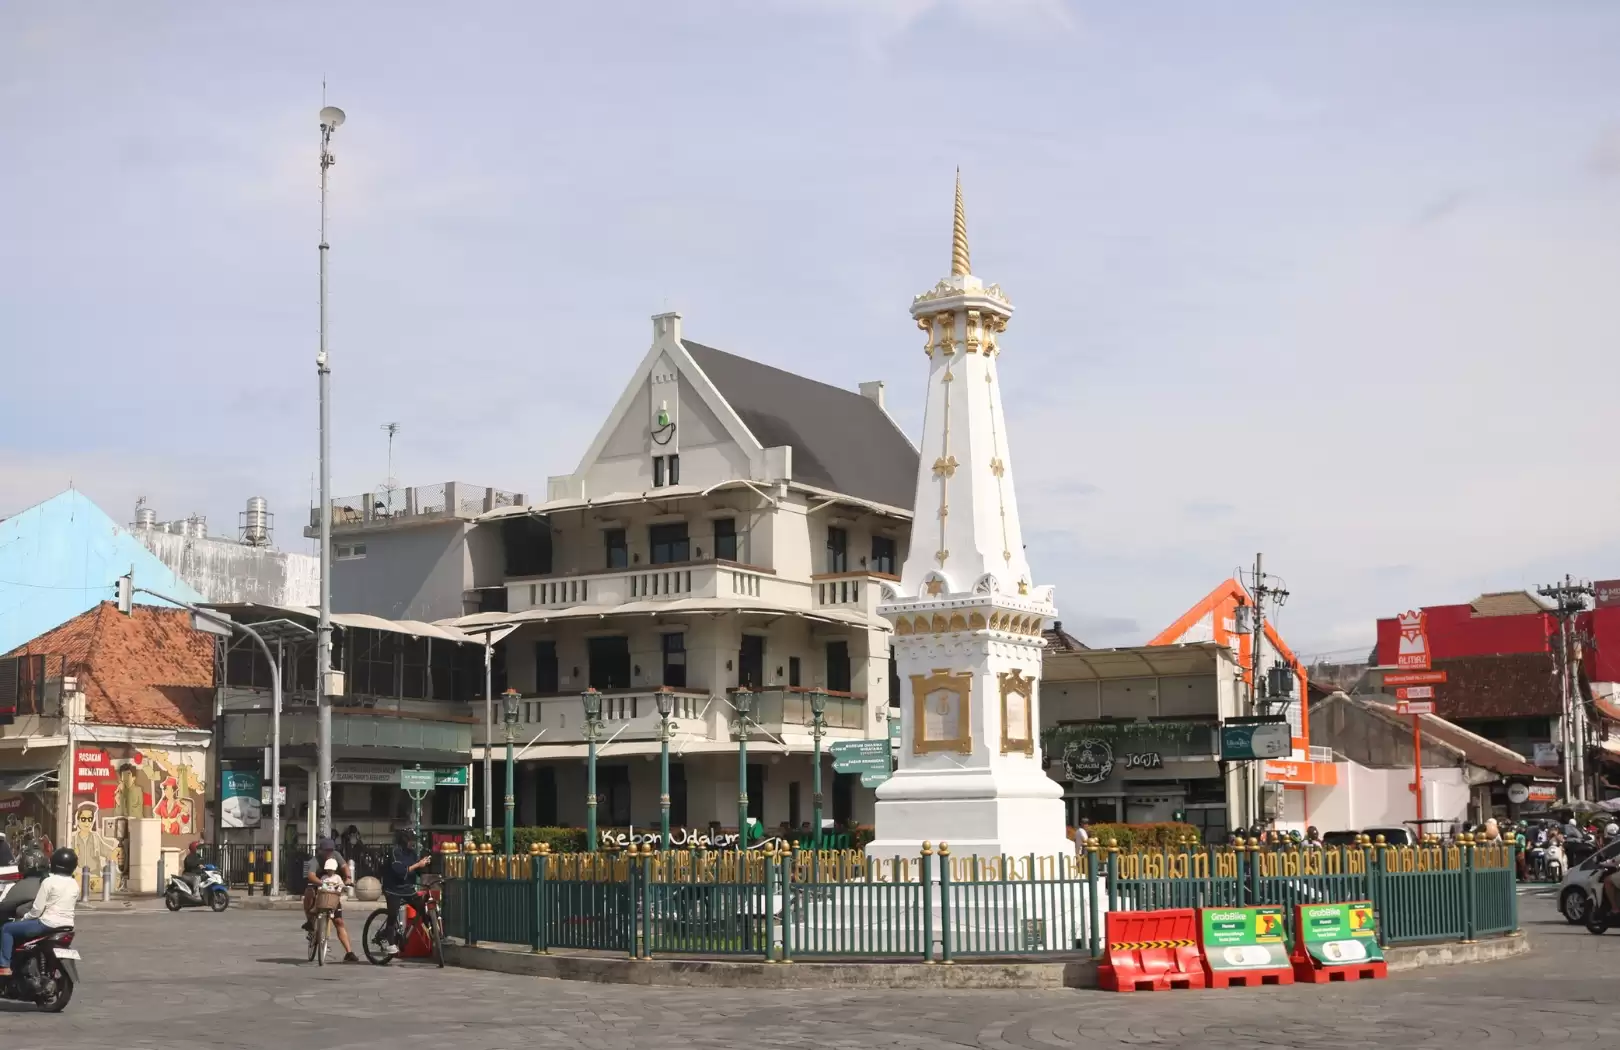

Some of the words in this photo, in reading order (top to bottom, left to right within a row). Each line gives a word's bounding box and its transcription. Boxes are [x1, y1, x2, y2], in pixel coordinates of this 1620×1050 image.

[1125, 752, 1160, 767] JOGJA
[601, 824, 662, 846] Kebon
[668, 827, 740, 846] Ndalem
[1211, 911, 1248, 921] GrabBike
